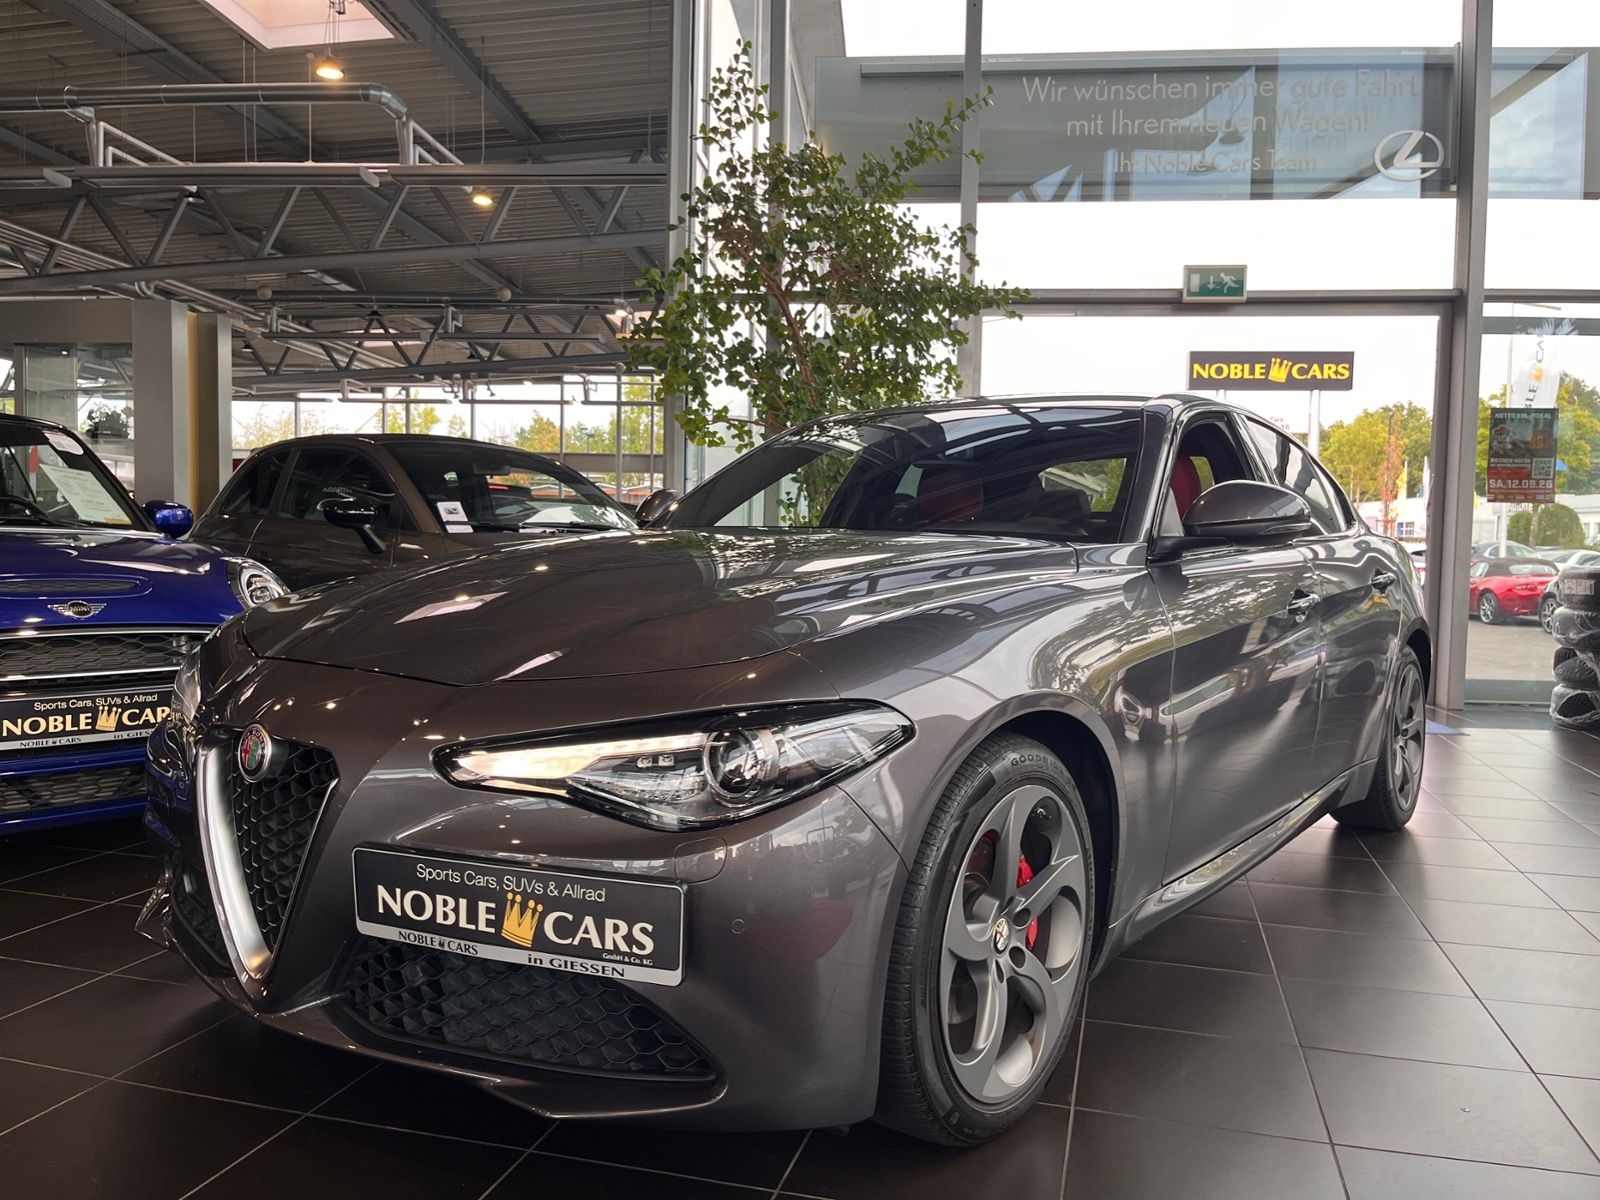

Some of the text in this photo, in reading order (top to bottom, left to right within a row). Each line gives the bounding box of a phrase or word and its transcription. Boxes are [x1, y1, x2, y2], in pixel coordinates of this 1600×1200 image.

[1022, 76, 1067, 103] Wir
[1073, 73, 1197, 101] wünschen
[1290, 76, 1348, 105] gute
[1355, 69, 1417, 99] Fahrt
[1066, 114, 1103, 136] mit
[1112, 110, 1184, 136] Ihrem
[1275, 106, 1370, 137] Wagen!
[1143, 150, 1207, 173] Noble
[1213, 151, 1261, 172] Cars
[1266, 149, 1317, 172] Team
[1193, 363, 1350, 380] NOBLE CARS
[34, 699, 67, 711] Sports
[96, 696, 122, 706] SUVs
[123, 695, 131, 704] &
[132, 693, 158, 703] Allrad
[2, 706, 171, 737] NOBLE CAR
[19, 736, 82, 748] NOBLE CARS
[416, 863, 606, 902] Sports Cars, SUVs & Allrad
[377, 884, 655, 955] NOBLE CARS
[398, 930, 478, 956] NOBLE CARS
[527, 953, 626, 978] in GIESSEN
